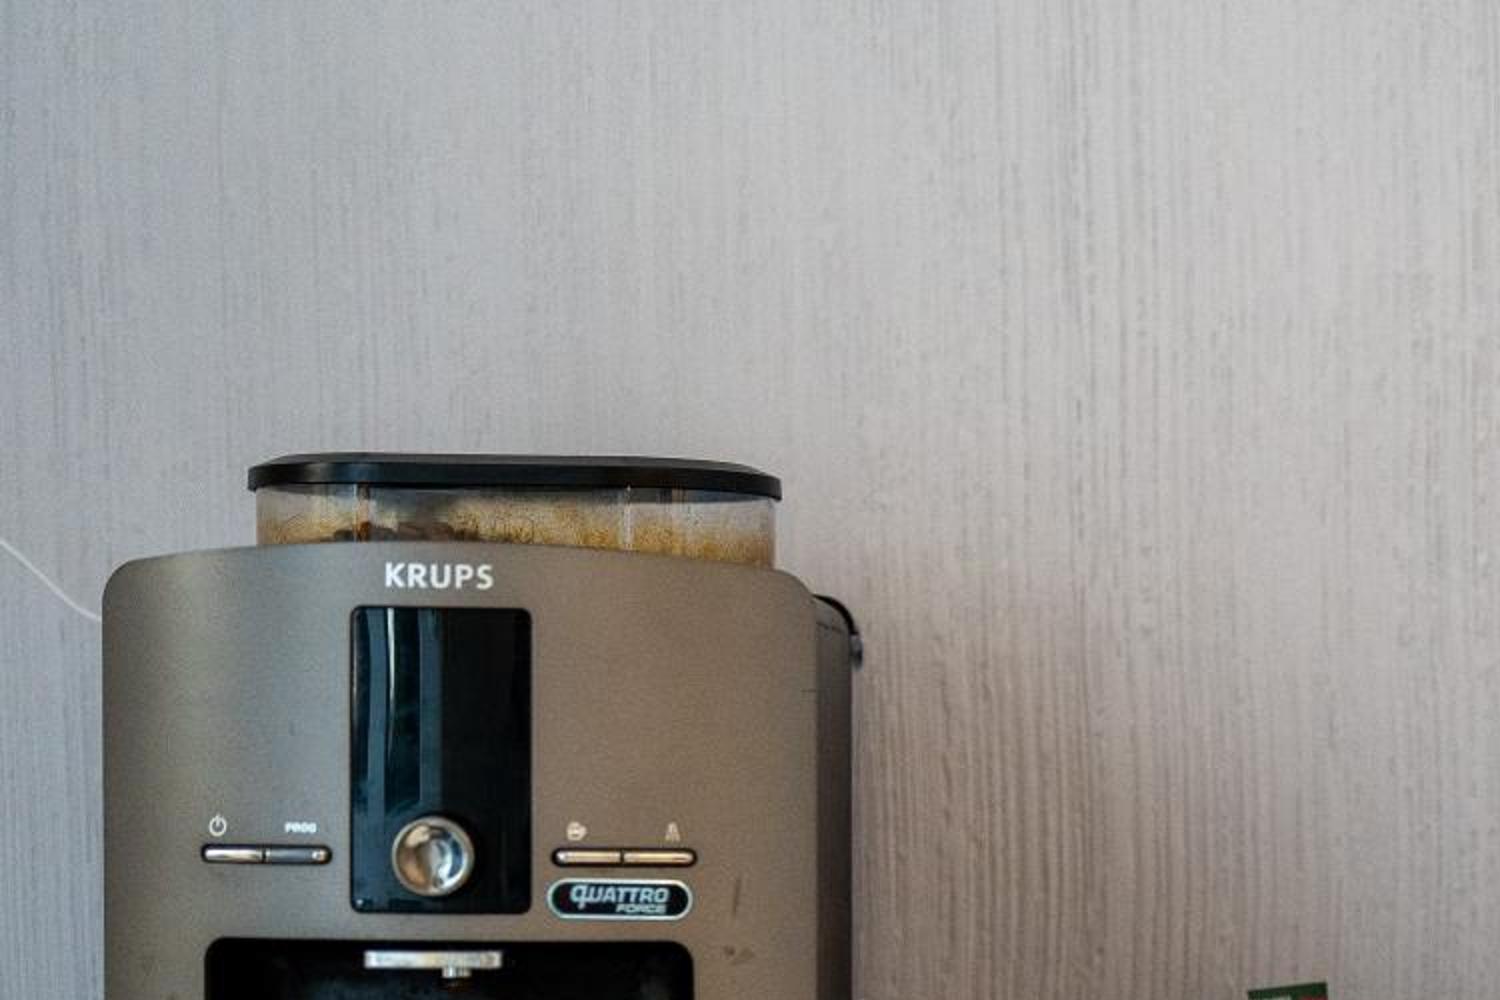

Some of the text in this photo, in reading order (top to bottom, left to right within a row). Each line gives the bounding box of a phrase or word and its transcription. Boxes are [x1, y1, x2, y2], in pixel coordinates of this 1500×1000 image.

[384, 561, 494, 590] KRUPS
[284, 821, 317, 833] PROG
[615, 904, 667, 914] FORCE
